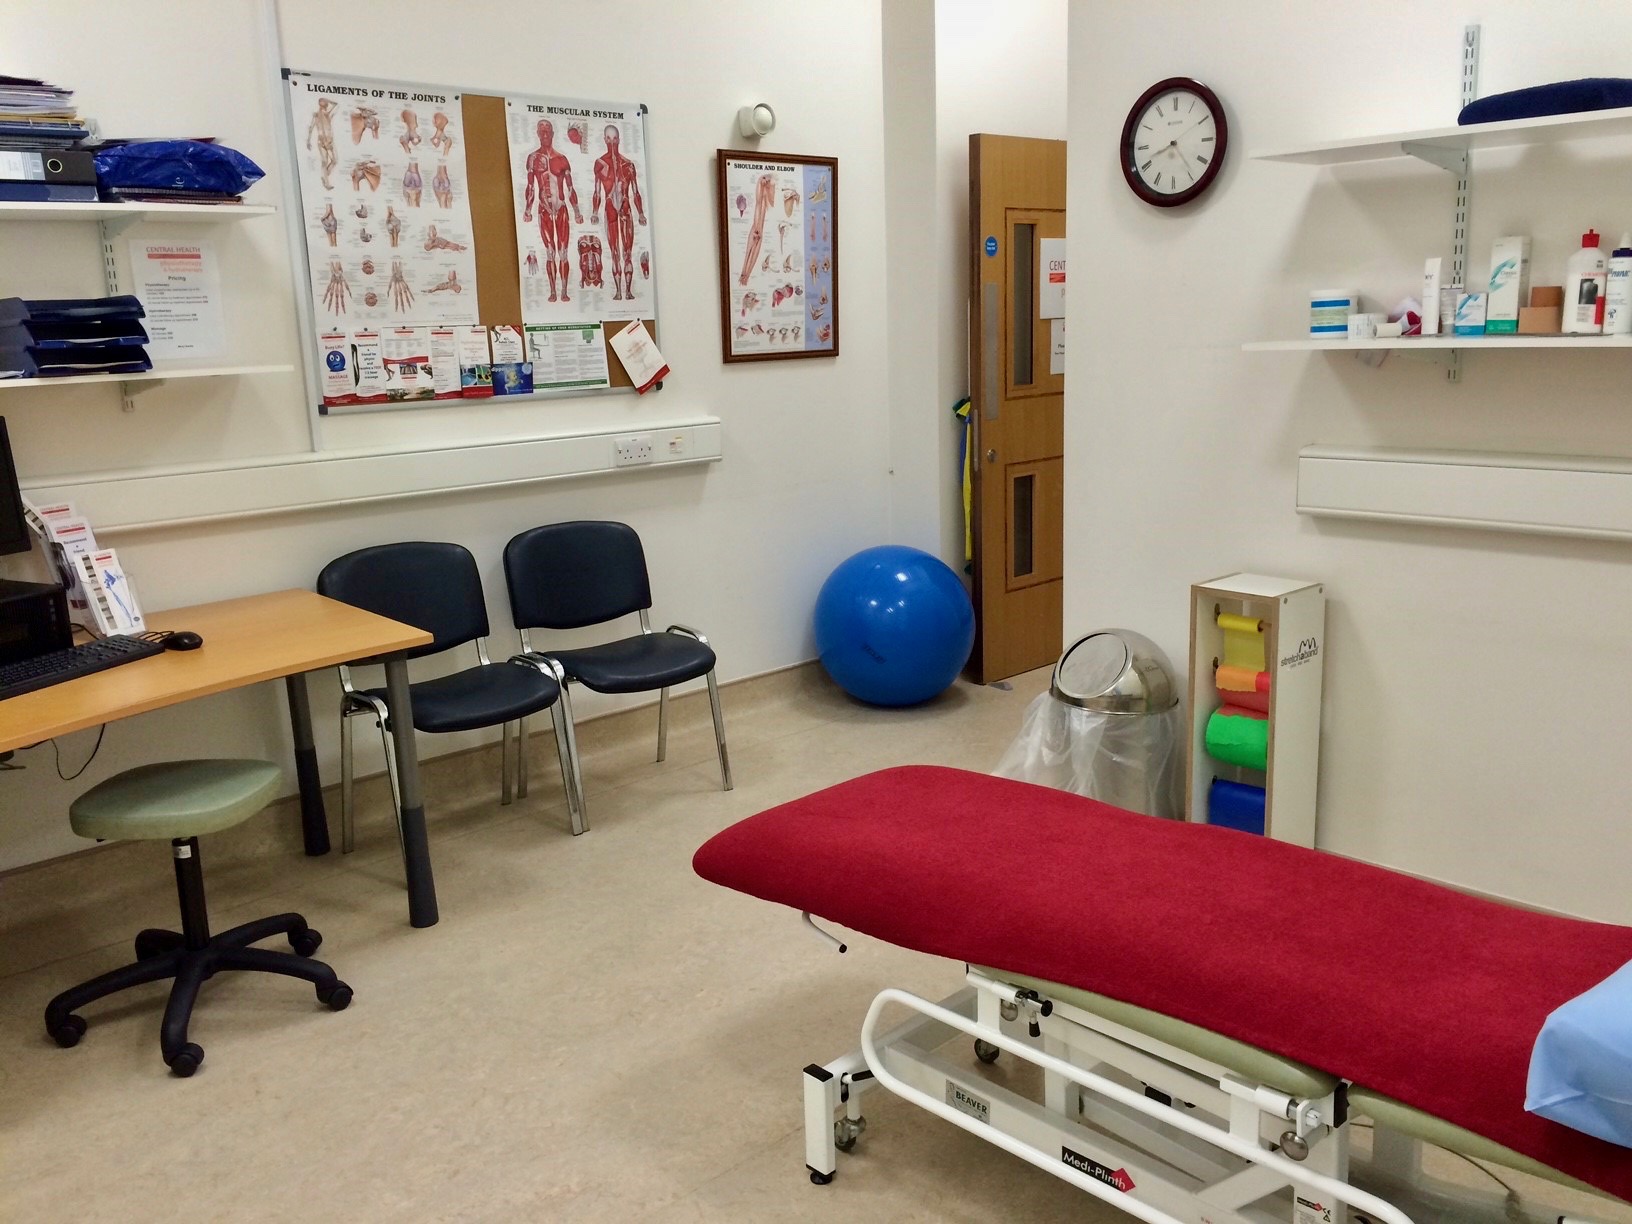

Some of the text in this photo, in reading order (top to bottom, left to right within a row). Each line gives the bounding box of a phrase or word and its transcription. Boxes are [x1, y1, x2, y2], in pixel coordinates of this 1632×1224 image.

[307, 83, 447, 104] LIGAMENTS OF THE JOINTS
[526, 104, 624, 120] THE MUSCULAR SYSTEM
[733, 162, 764, 171] SHOULDER
[63, 537, 87, 545] Recommend
[955, 1090, 988, 1115] BEAVER
[1062, 1151, 1127, 1190] Medi-Plinth
